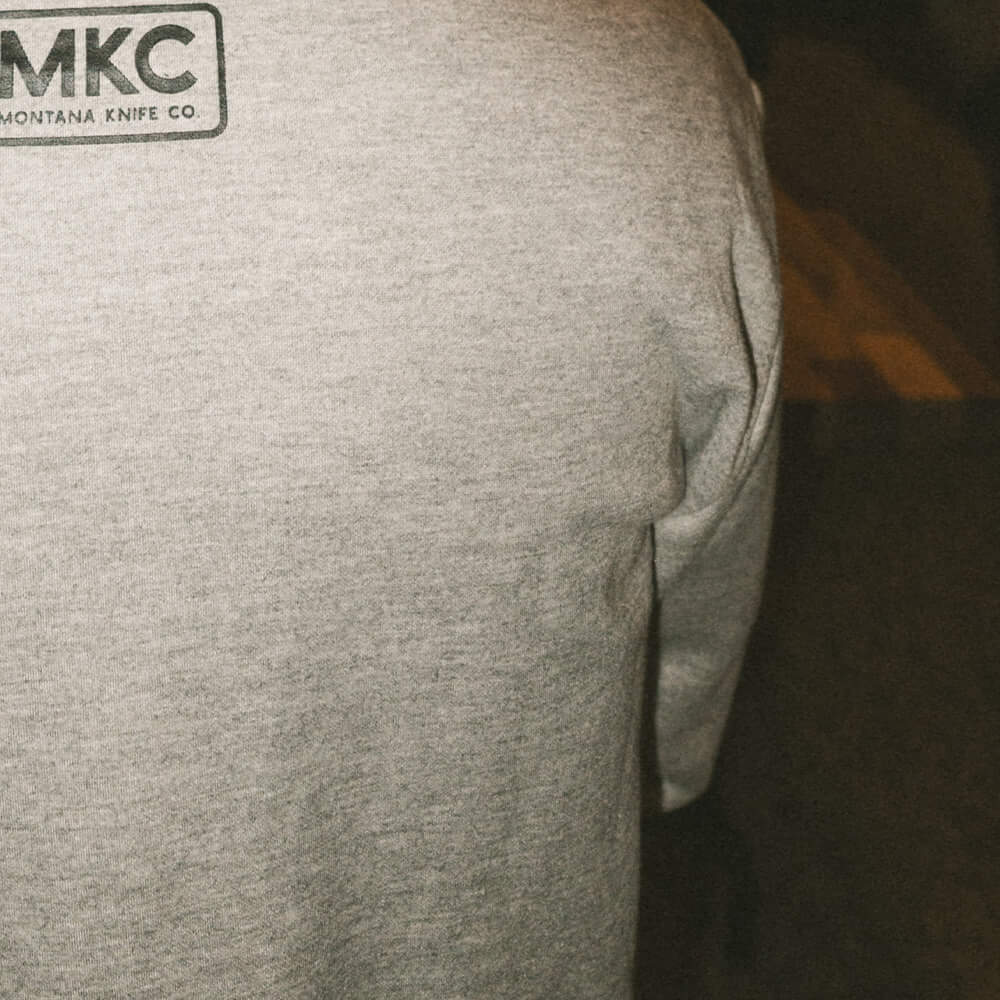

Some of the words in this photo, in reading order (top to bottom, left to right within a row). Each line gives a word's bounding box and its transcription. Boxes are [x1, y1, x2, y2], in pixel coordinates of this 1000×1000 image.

[0, 23, 198, 99] MKC
[105, 105, 158, 123] KNIFE
[168, 104, 201, 120] CO.
